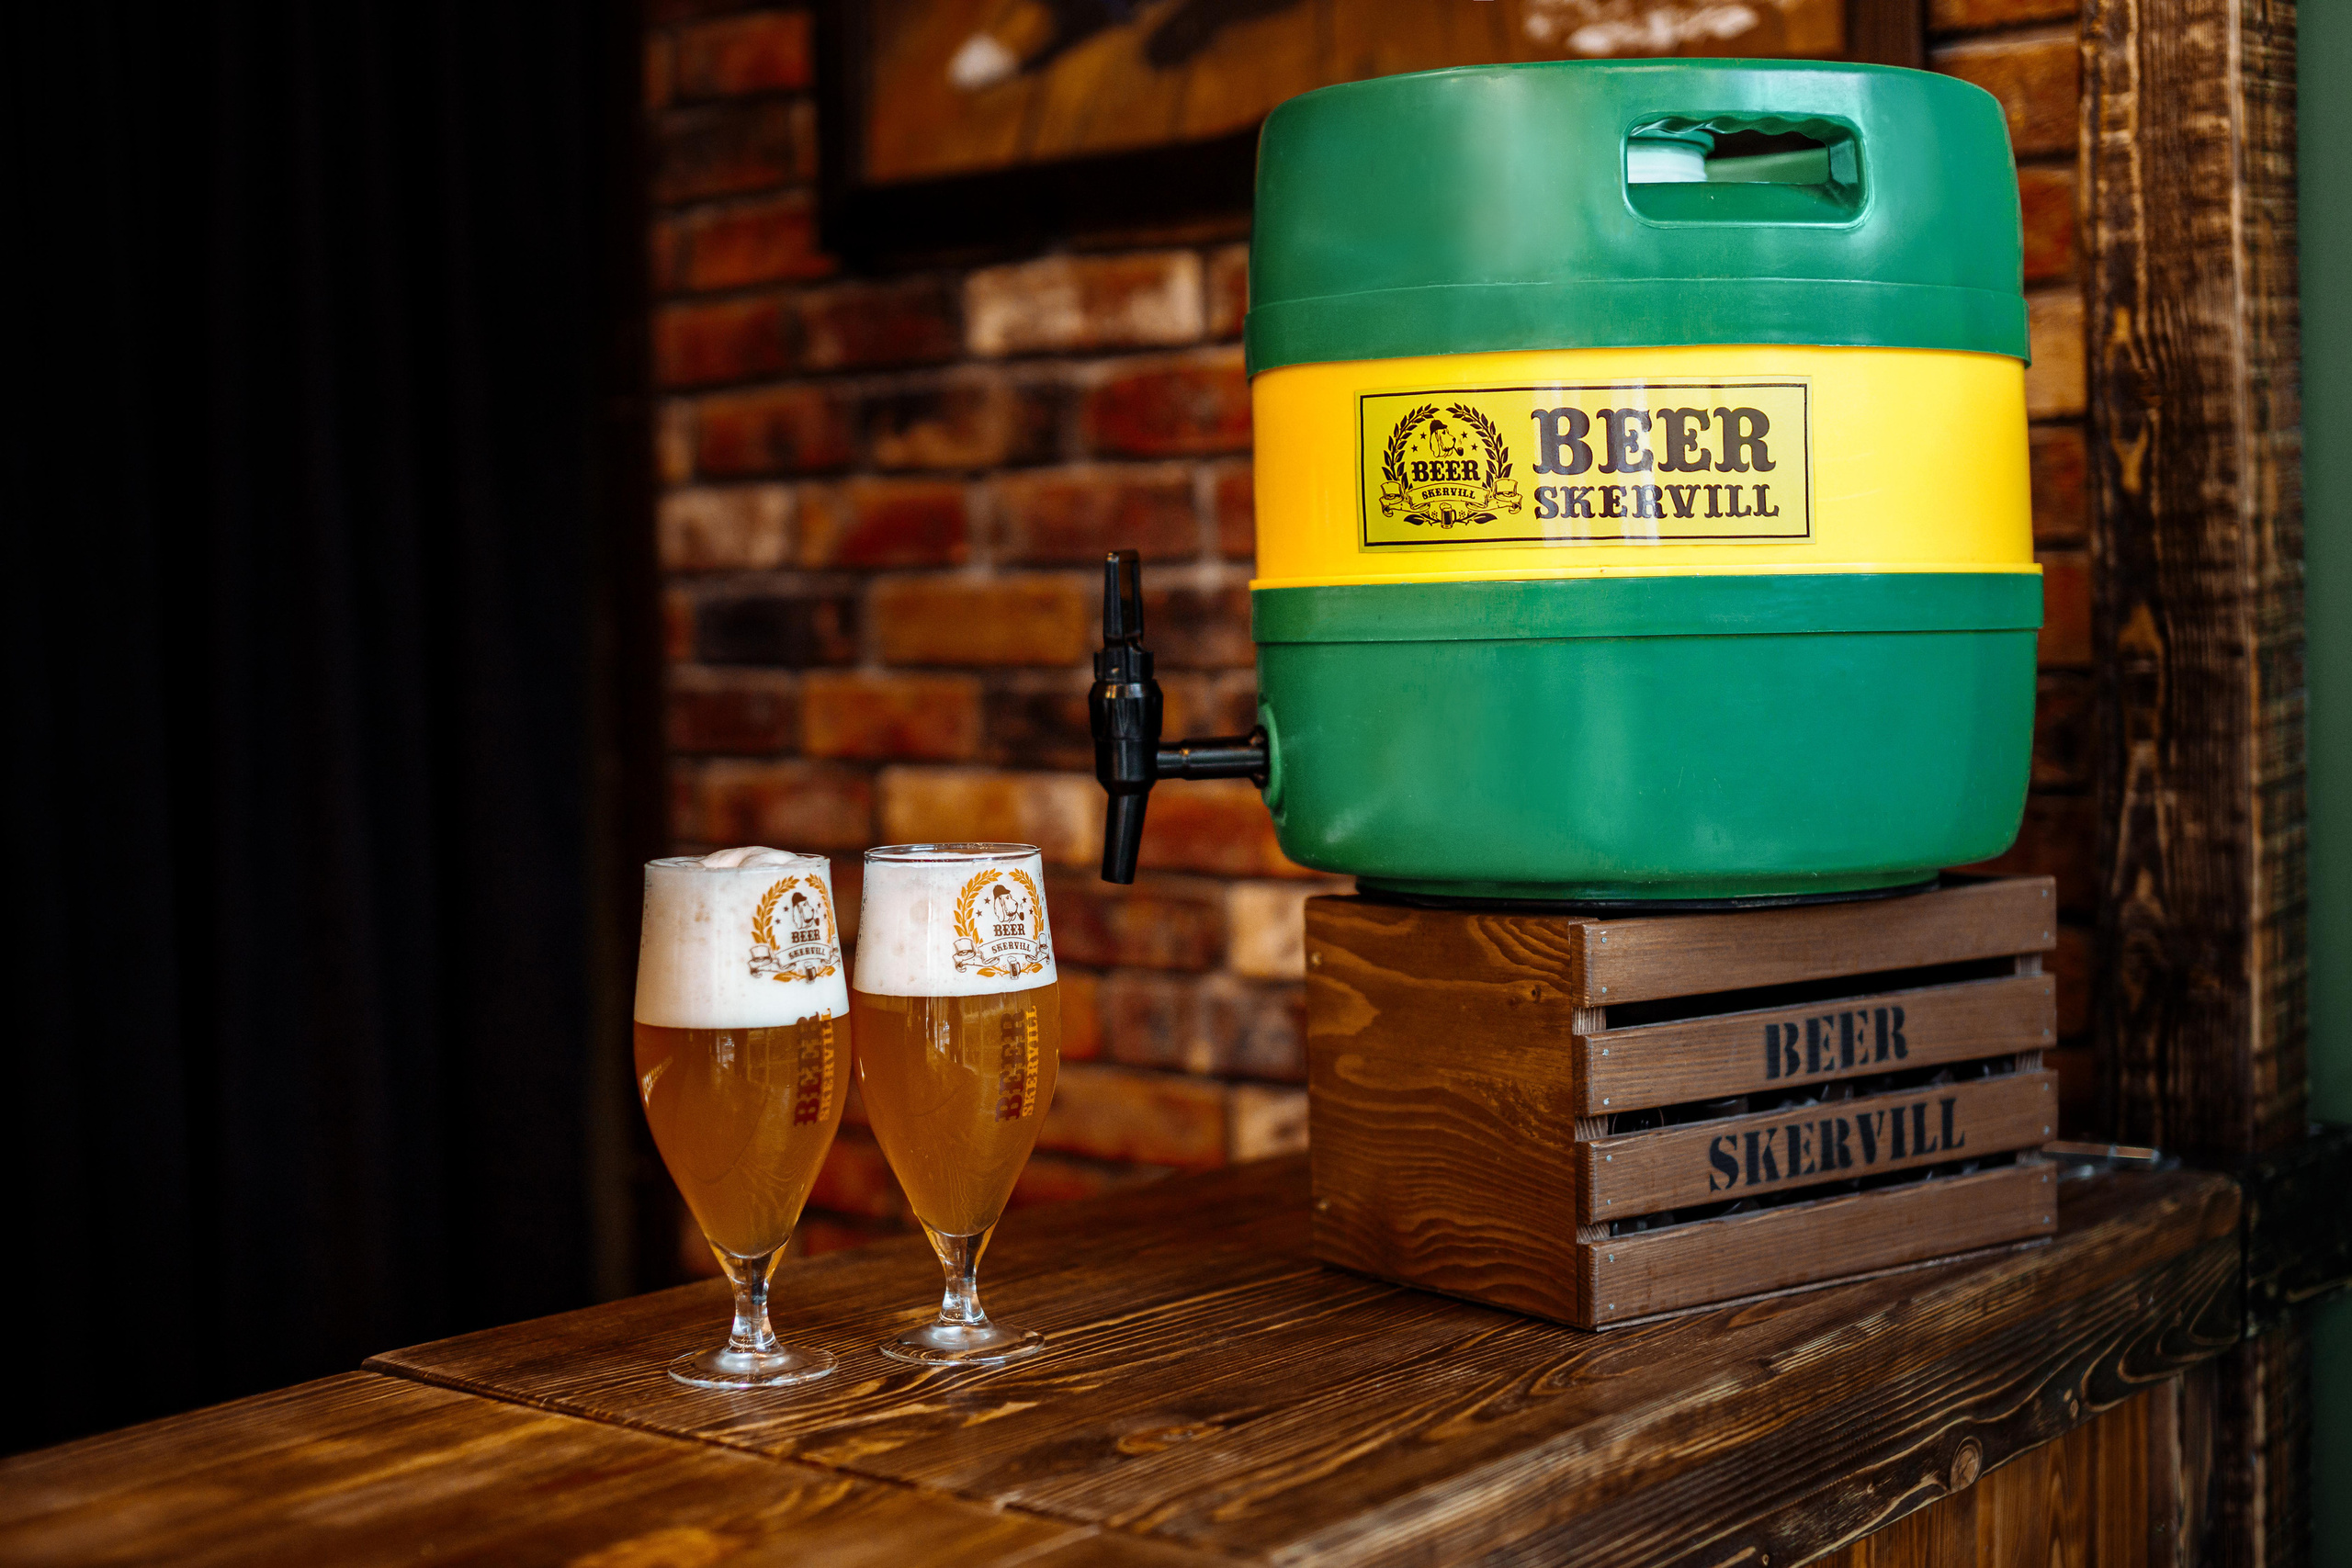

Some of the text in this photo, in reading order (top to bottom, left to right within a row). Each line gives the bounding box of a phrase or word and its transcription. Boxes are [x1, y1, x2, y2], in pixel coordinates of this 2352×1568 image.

[1531, 408, 1776, 475] BEER
[1410, 459, 1481, 482] BEER
[1421, 487, 1476, 501] SKERVILL
[1533, 484, 1780, 520] SKERVILL
[791, 929, 820, 943] BEER
[991, 942, 1031, 953] SKERVILL
[993, 923, 1025, 936] BEER
[788, 946, 826, 959] SKERVILL
[1765, 1006, 1908, 1078] BEER
[793, 1010, 822, 1127] BEER
[994, 1009, 1025, 1122] BEER
[1022, 1005, 1039, 1117] SKERVILL
[1709, 1098, 1965, 1192] SKERVILL
